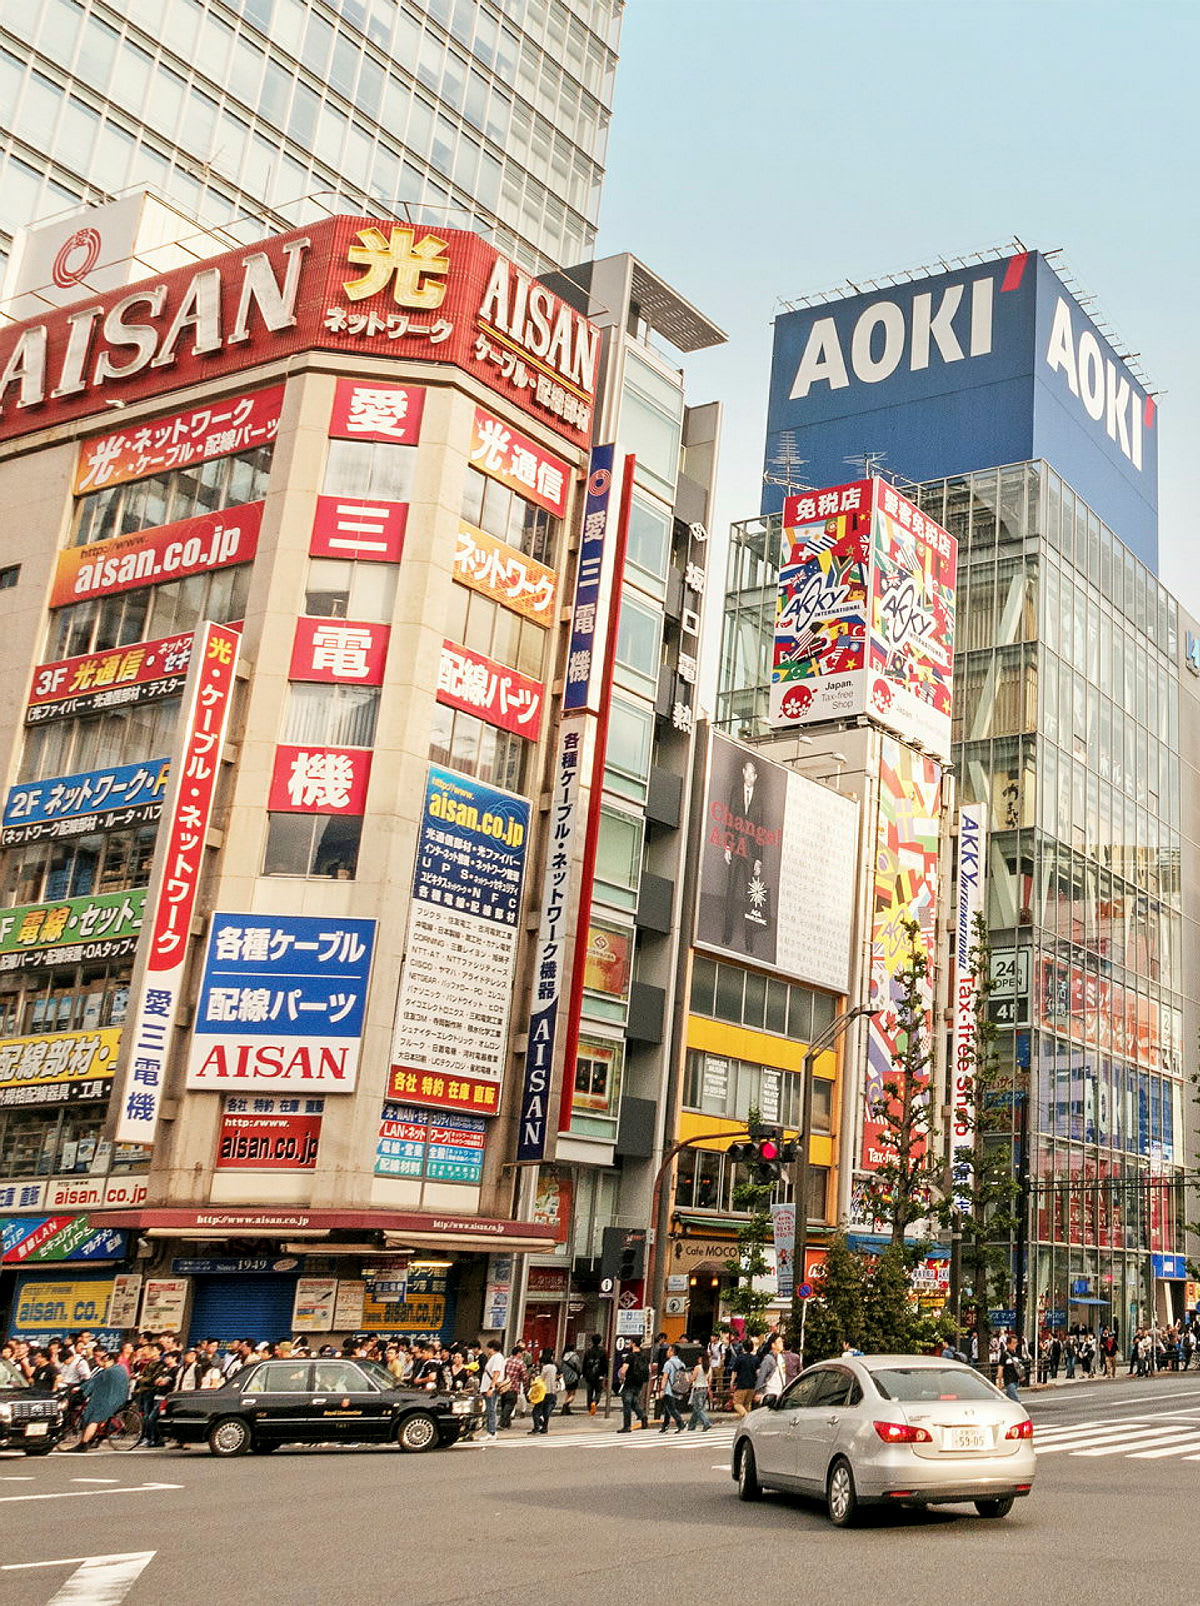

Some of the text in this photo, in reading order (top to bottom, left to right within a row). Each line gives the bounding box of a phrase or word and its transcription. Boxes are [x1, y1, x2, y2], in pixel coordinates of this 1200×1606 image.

[344, 226, 450, 309] 光
[0, 236, 310, 414] AISAN
[324, 306, 453, 344] ネットワーク
[480, 256, 600, 394] AISAN
[789, 276, 994, 400] AOKI
[347, 388, 408, 437] 愛
[1046, 296, 1142, 472] AOKI
[471, 419, 564, 506] 光通信
[328, 504, 390, 552] 三
[796, 487, 862, 521] 免税店
[74, 525, 241, 594] aisan.co.jp
[455, 532, 554, 613] ネットワーク
[568, 510, 606, 682] 愛三電機
[814, 604, 860, 617] INTERNATIONAL
[311, 624, 372, 678] 電
[672, 562, 704, 735] 坂口電熱
[36, 667, 68, 696] 3F
[437, 648, 540, 724] 配線パーツ
[825, 679, 854, 691] Japan.
[832, 700, 854, 710] Shop
[9, 789, 42, 818] 2F
[156, 636, 232, 954] 光・ケーブル・ネットワーク
[287, 751, 354, 808] 機
[429, 792, 524, 848] aisan.co.jp
[961, 813, 979, 888] AKKY
[216, 926, 367, 963] 各種ケーブル
[958, 869, 969, 970] INTERNATIONAL
[206, 988, 357, 1023] 配線パーツ
[957, 976, 975, 1072] Tax-free
[126, 988, 172, 1122] 愛三電機
[196, 1045, 349, 1080] AISAN
[394, 1072, 417, 1092] 各社
[421, 1076, 445, 1097] 特約
[448, 1081, 471, 1101] 在庫
[523, 1019, 550, 1146] AISAN
[220, 1130, 320, 1165] aisan.co.jp
